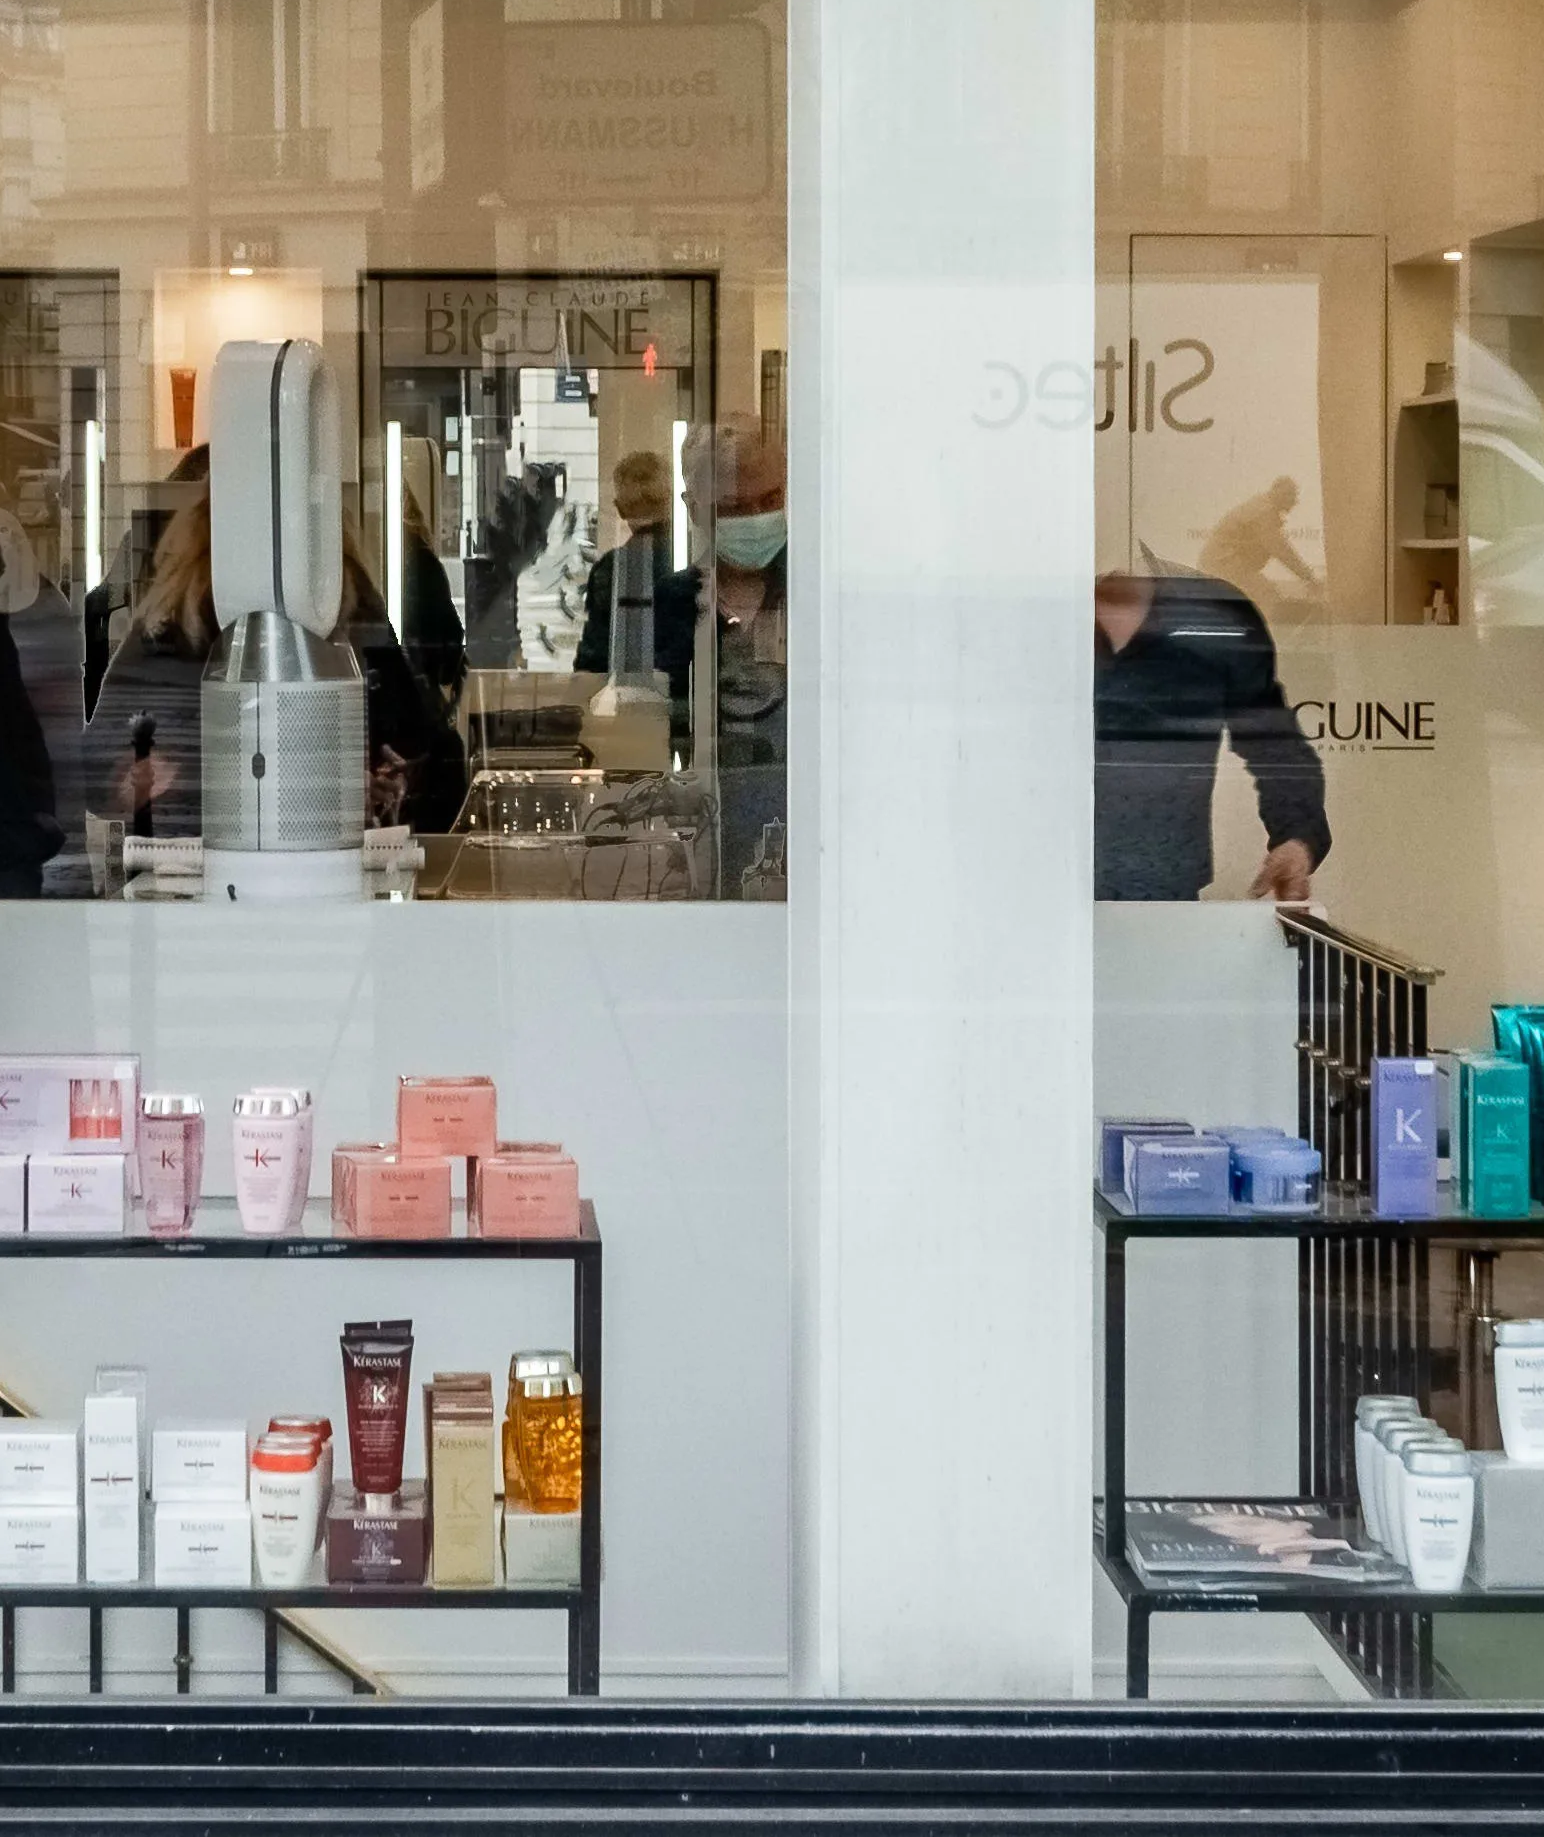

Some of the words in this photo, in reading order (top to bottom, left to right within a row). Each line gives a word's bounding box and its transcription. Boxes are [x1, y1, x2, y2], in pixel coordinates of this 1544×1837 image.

[424, 308, 650, 356] BIGUINE
[1395, 1107, 1423, 1144] K
[353, 1355, 403, 1368] KÉRASTASE
[373, 1385, 387, 1404] K
[353, 1519, 399, 1531] KÉRASTASE
